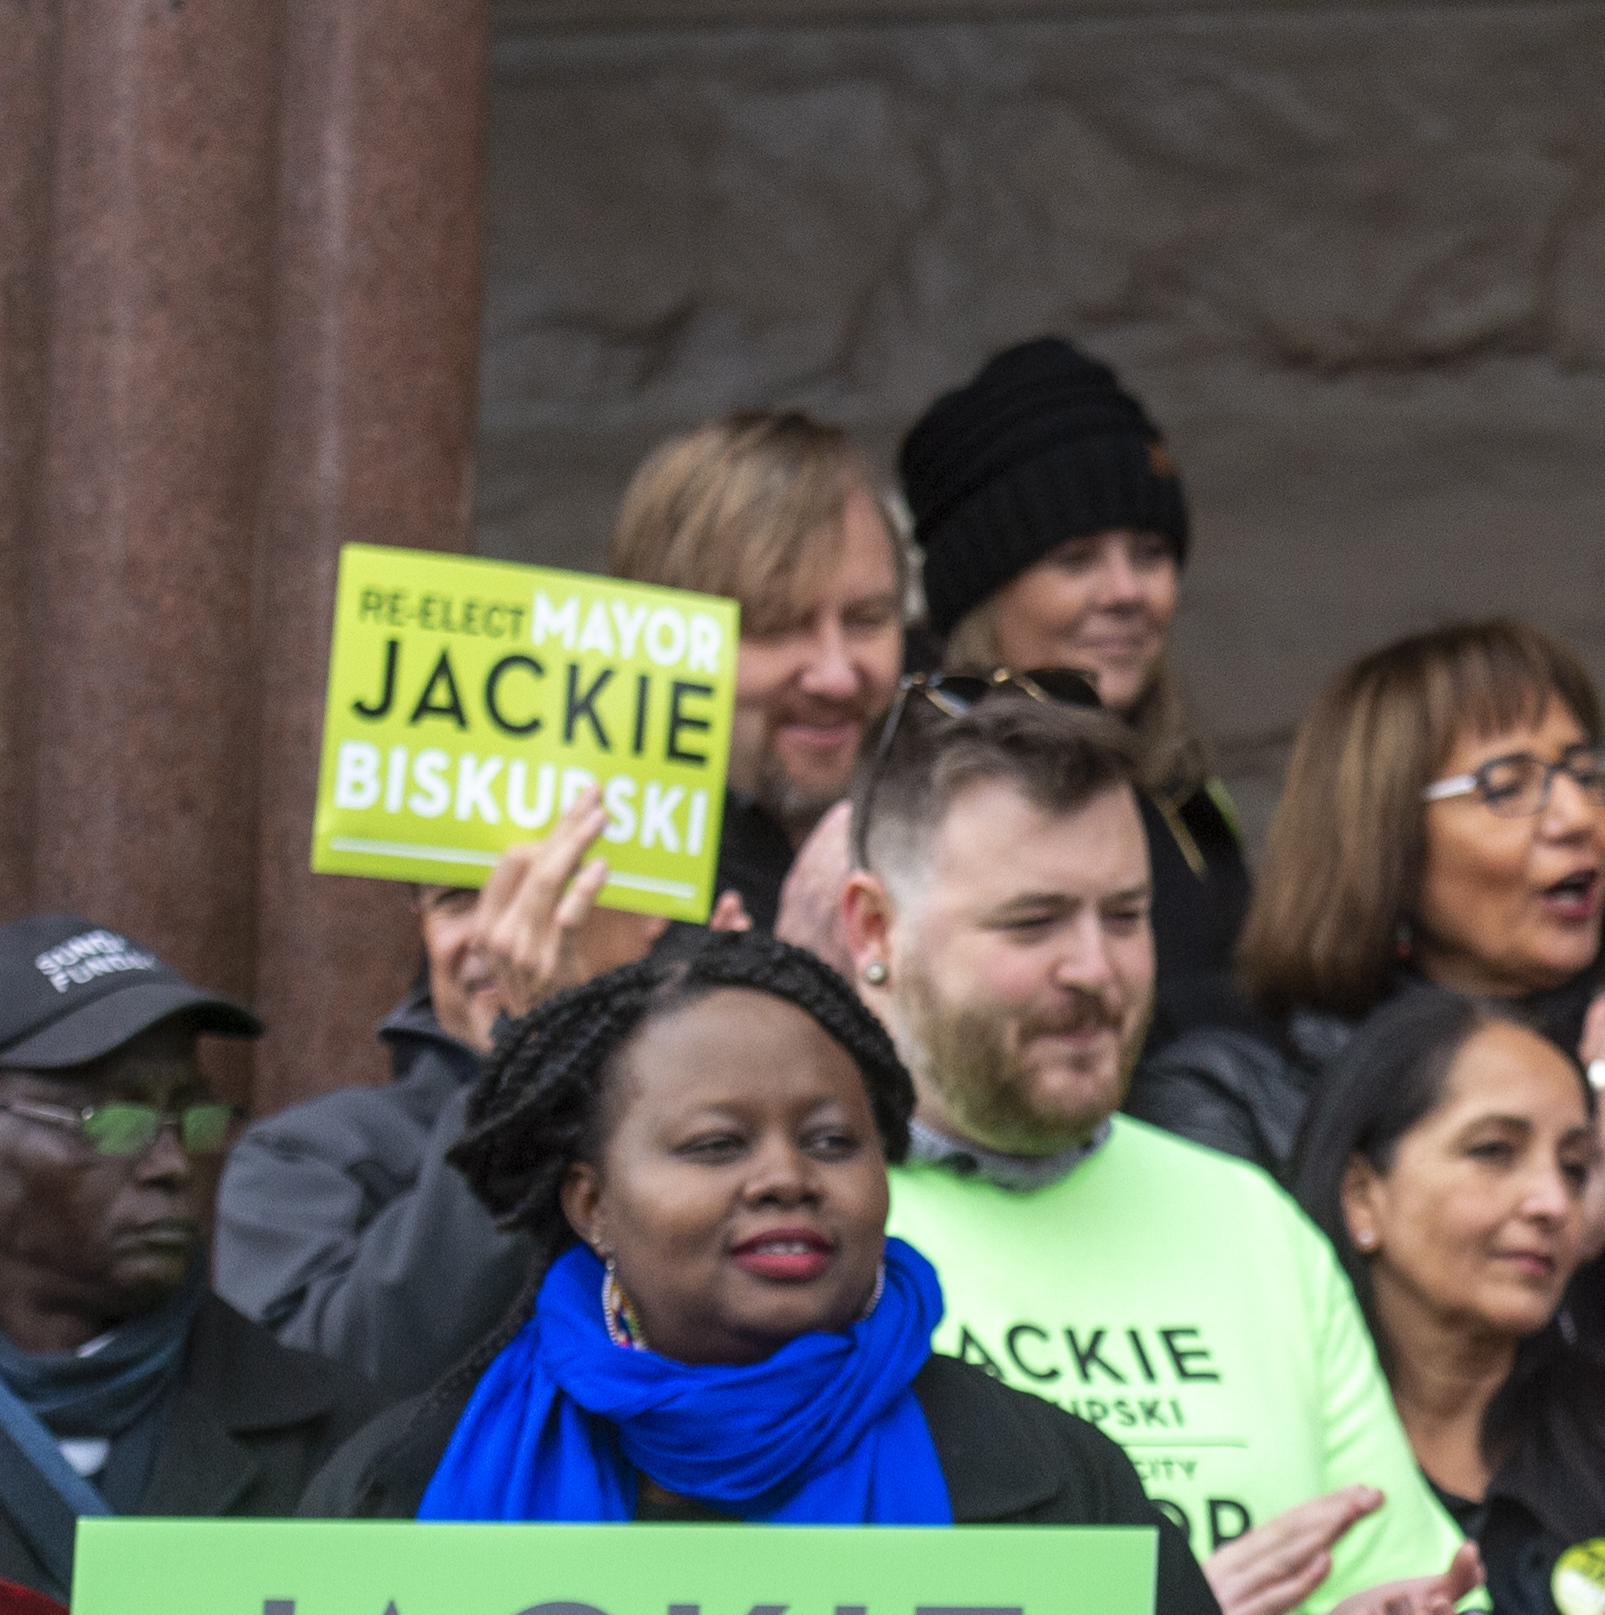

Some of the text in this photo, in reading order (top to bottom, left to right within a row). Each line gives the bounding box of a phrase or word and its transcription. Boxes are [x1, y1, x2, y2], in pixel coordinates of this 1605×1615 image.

[360, 585, 723, 673] RE-ELECT MAYOR
[352, 638, 716, 769] JACKIE
[959, 1324, 1221, 1384] ACKIE
